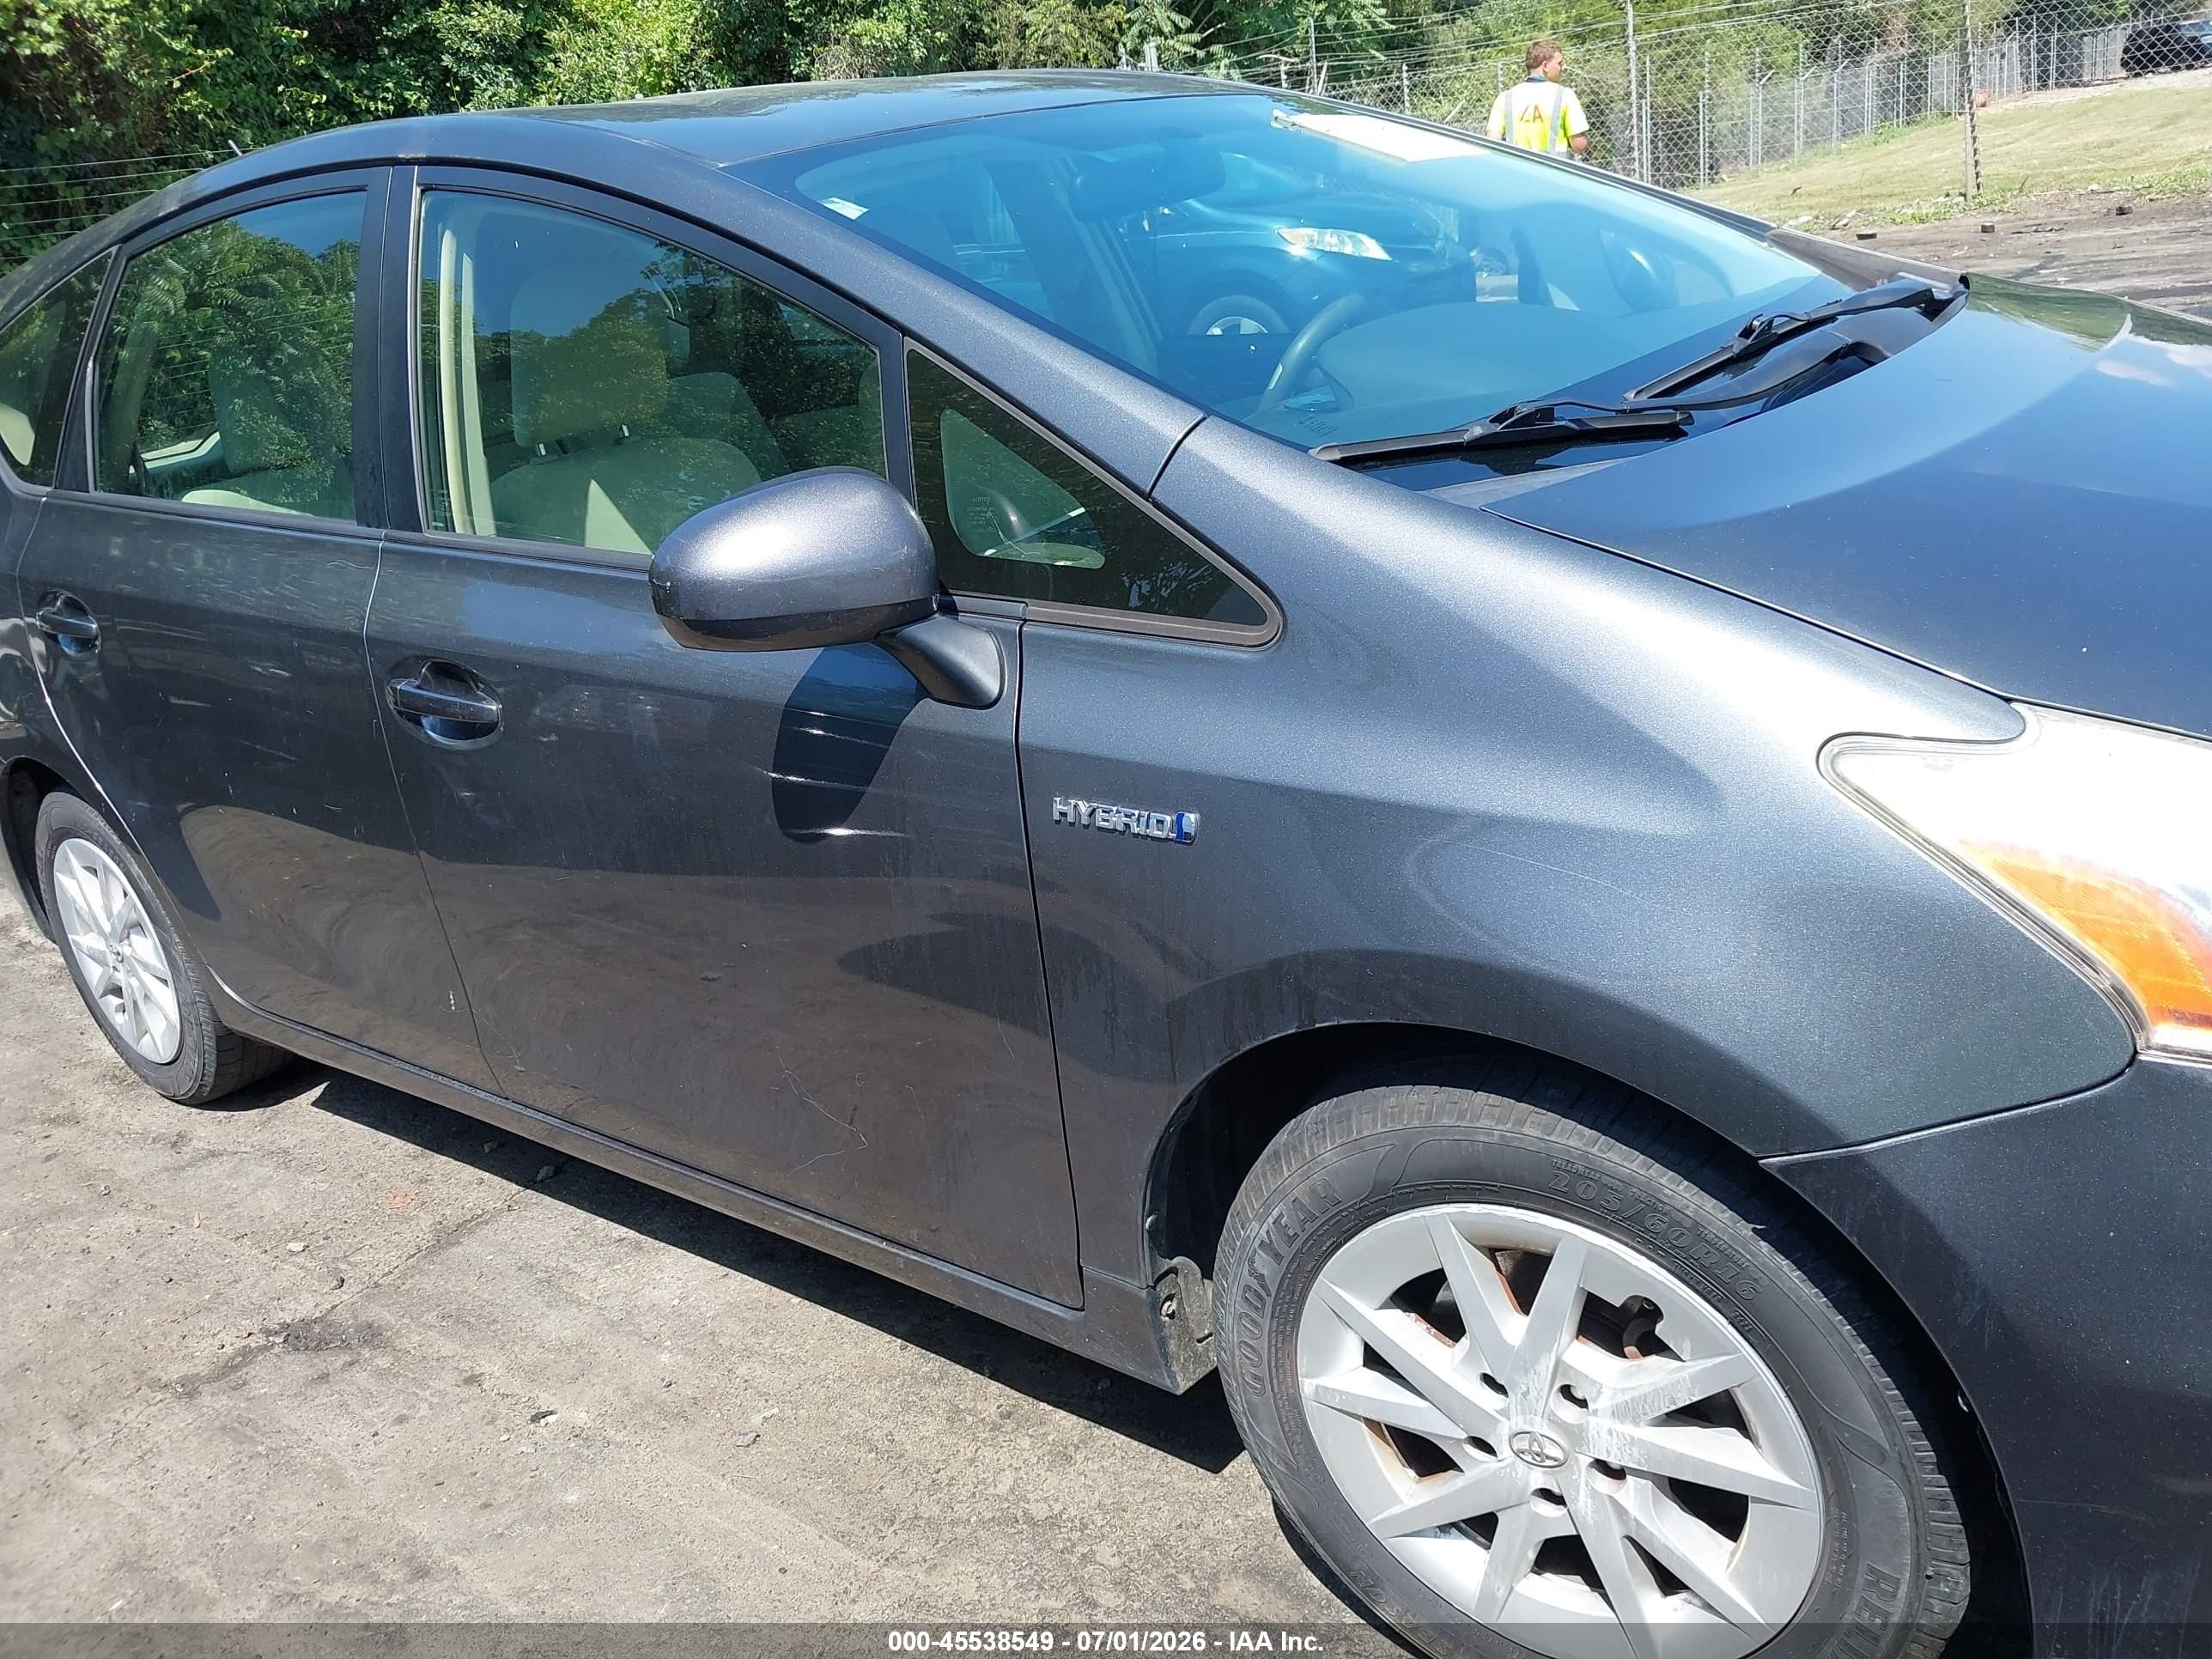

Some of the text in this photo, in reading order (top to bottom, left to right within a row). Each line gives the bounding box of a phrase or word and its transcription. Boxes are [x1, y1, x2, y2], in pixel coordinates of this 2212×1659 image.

[1052, 797, 1175, 840] HYBRID
[1548, 1170, 1762, 1301] 205/60R16
[1829, 1560, 1901, 1659] RELI
